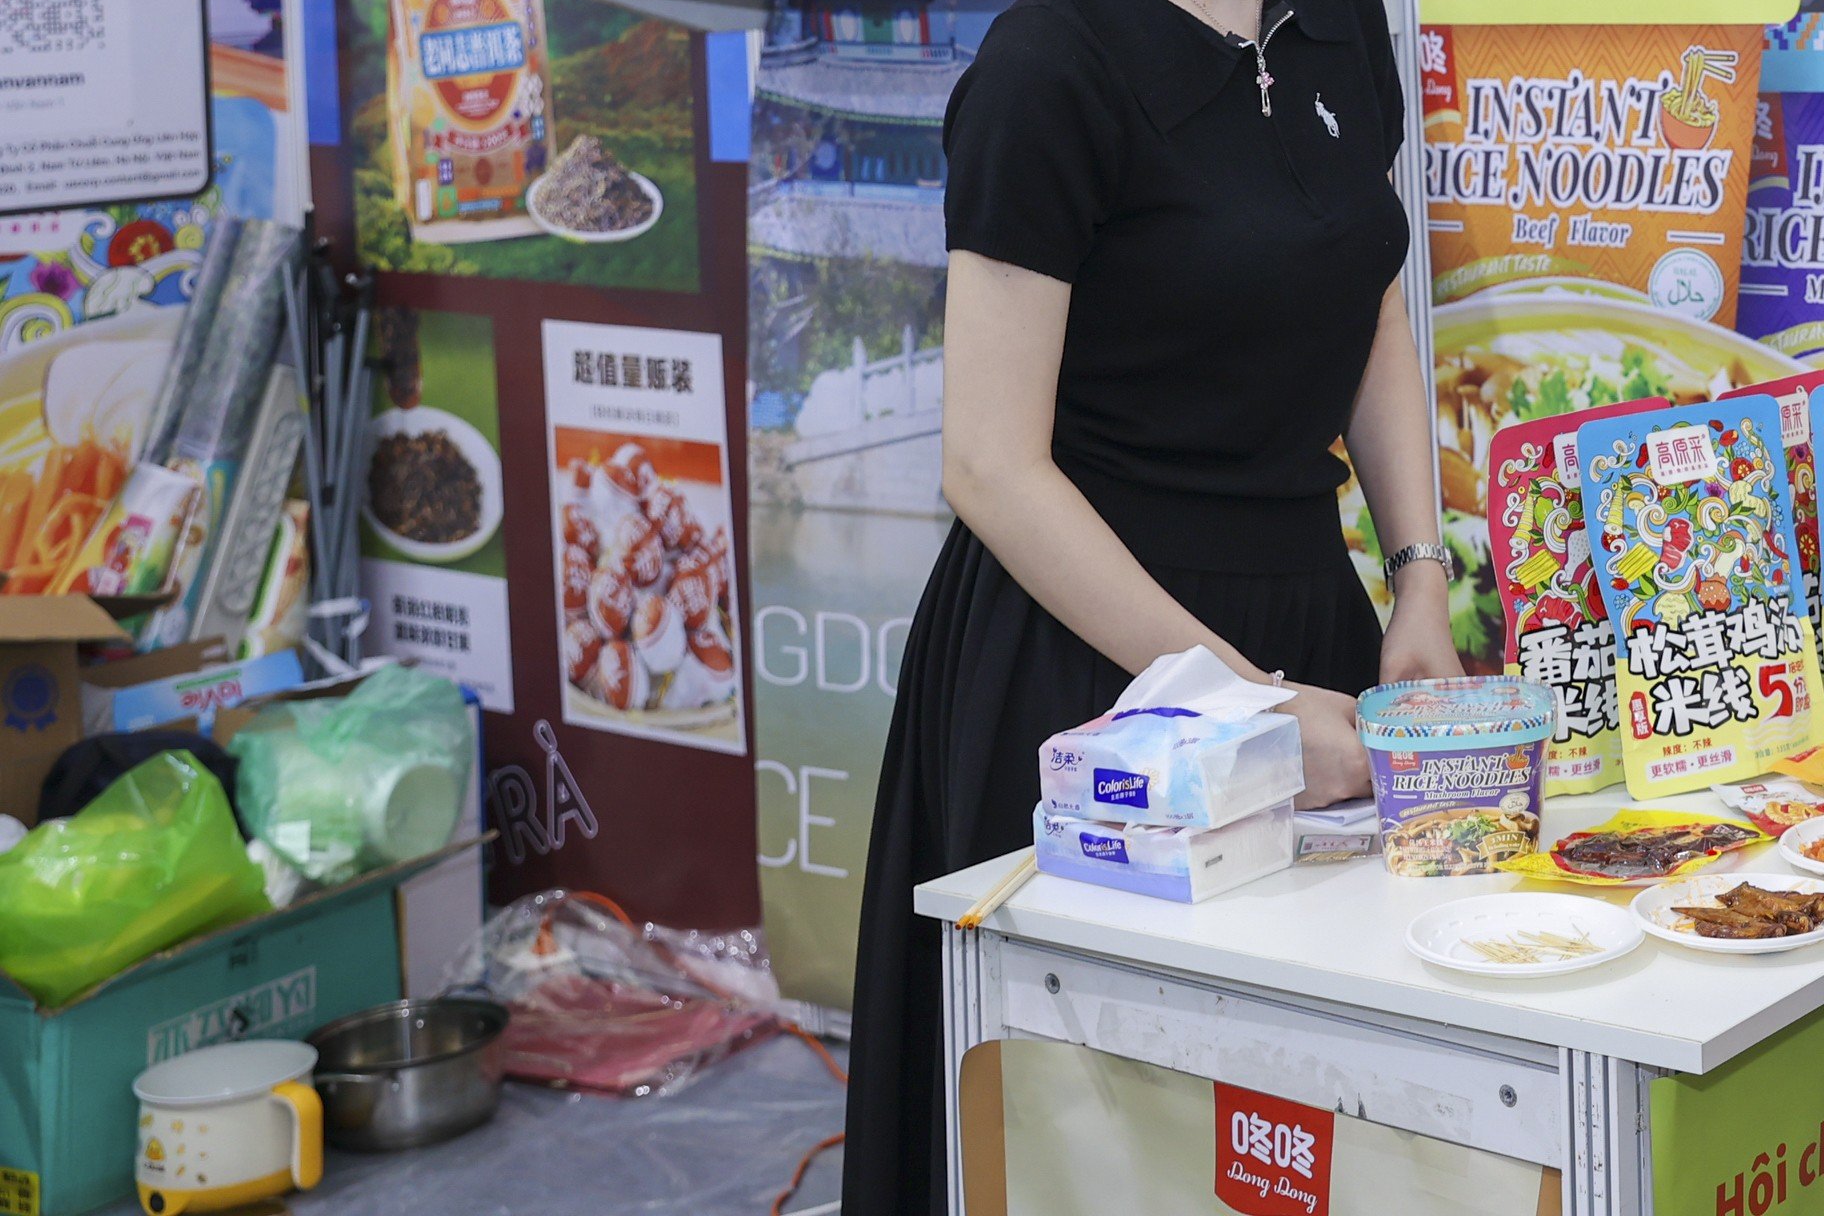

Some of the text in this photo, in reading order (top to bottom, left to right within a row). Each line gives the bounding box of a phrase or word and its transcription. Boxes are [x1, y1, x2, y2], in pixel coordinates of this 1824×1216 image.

[1466, 69, 1674, 147] INSTANT
[1425, 143, 1734, 215] RICE NOODLES
[1511, 213, 1633, 248] Beef Flavor
[1667, 279, 1705, 306] حلال
[1655, 435, 1706, 470] 高原采
[1629, 596, 1804, 676] 松茸鸡汤
[1652, 666, 1758, 736] 米线
[1758, 663, 1794, 719] 5
[1393, 766, 1532, 791] RICE NOODLES
[1422, 753, 1508, 775] INSTANT
[1424, 788, 1500, 801] Mushroom Flavor
[1231, 1110, 1315, 1180] 咚咚
[1227, 1160, 1318, 1214] Dong Dong
